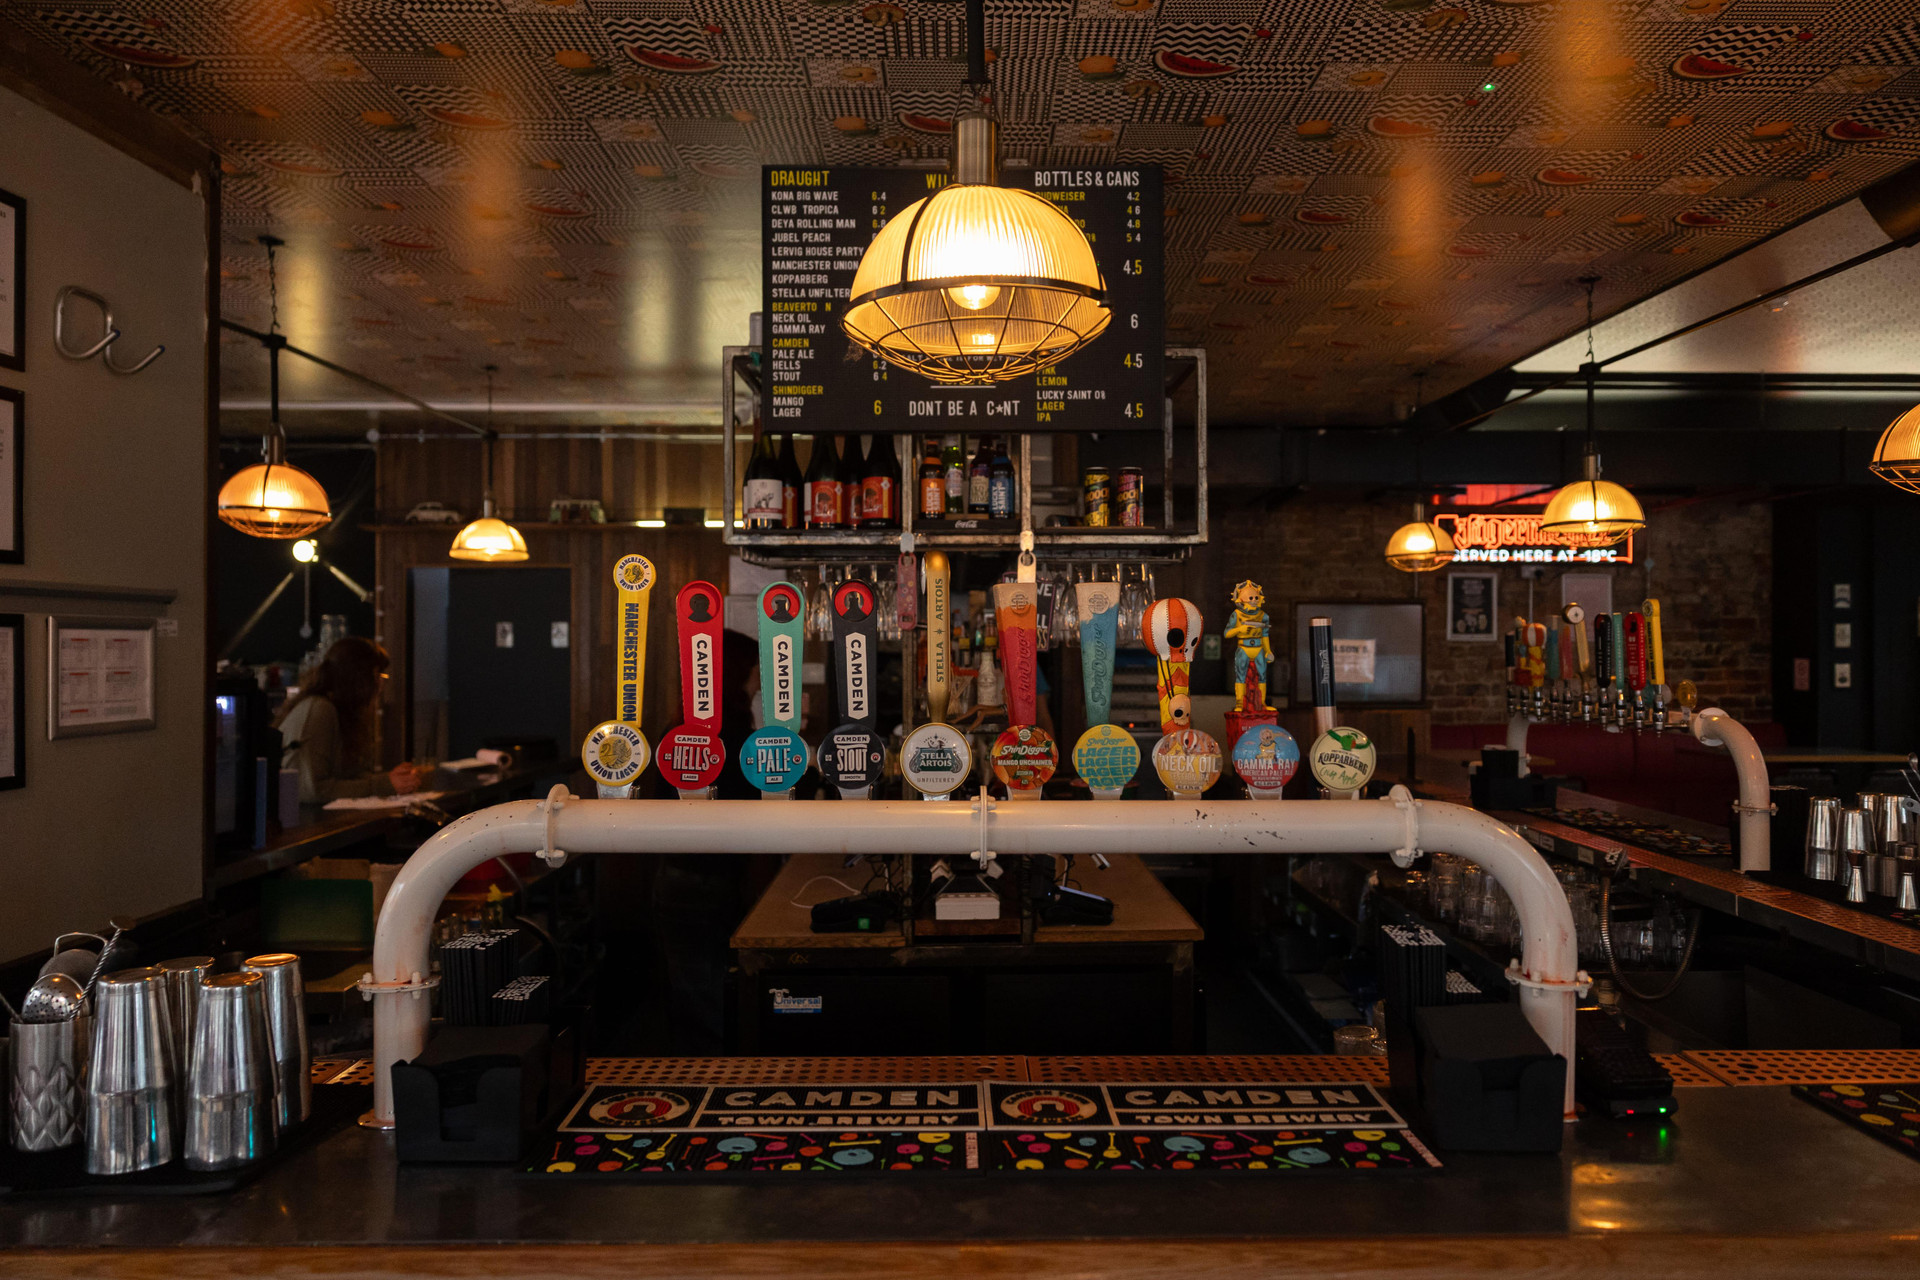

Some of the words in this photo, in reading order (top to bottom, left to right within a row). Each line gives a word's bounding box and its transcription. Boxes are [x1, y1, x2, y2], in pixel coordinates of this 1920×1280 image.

[771, 170, 830, 187] DRAUGHT
[1034, 170, 1092, 187] BOTTLES
[1095, 170, 1103, 187] &
[1106, 170, 1140, 187] CANS
[771, 191, 794, 201] KONA
[796, 191, 811, 201] BIG
[813, 191, 839, 201] WAVE
[1126, 191, 1141, 201] 4.2
[771, 205, 797, 215] CLWB
[803, 205, 839, 215] TROPICA
[771, 219, 795, 229] DEYA
[797, 219, 833, 229] ROLLING
[836, 219, 856, 229] MAN
[772, 233, 800, 243] JUBEL
[802, 233, 831, 243] PEACH
[771, 247, 803, 257] LERVIG
[805, 247, 833, 257] HOUSE
[836, 247, 864, 257] PARTY
[772, 261, 831, 271] MANCHESTER
[833, 261, 859, 271] UNION
[1123, 260, 1142, 275] 4.5
[772, 274, 828, 284] KOPPARBERG
[772, 288, 806, 298] STELLA
[772, 313, 794, 323] NECK
[797, 313, 811, 323] OIL
[1130, 313, 1139, 329] 6
[772, 324, 806, 334] GAMMA
[808, 324, 826, 334] RAY
[772, 338, 809, 348] CAMDEN
[772, 349, 795, 359] PALE
[797, 349, 814, 359] ALE
[772, 360, 801, 370] HELLS
[1123, 353, 1143, 368] 4.5
[772, 371, 801, 381] STOUT
[1036, 376, 1068, 386] LEMON
[772, 385, 823, 395] SHINDIGGER
[1036, 390, 1065, 400] LUCKY
[1067, 390, 1092, 400] SAINT
[772, 396, 804, 406] MANGO
[1036, 401, 1065, 411] LAGER
[873, 399, 882, 415] 6
[909, 400, 943, 416] DONT
[948, 400, 964, 416] BE
[969, 400, 978, 416] A
[1124, 403, 1144, 418] 4.5
[772, 408, 801, 418] LAGER
[1036, 412, 1051, 422] IPA
[1452, 548, 1510, 562] SERVED
[1512, 548, 1553, 562] HERE
[1556, 548, 1577, 562] AT
[619, 556, 649, 569] MANCHESTER
[620, 579, 634, 590] UNION
[635, 579, 649, 590] LAGER
[934, 578, 944, 623] ARTOIS
[622, 602, 640, 681] MANCHESTER
[936, 641, 944, 683] STELLA
[696, 640, 710, 712] CAMDEN
[777, 641, 790, 713] CAMDEN
[850, 639, 864, 711] CAMDEN
[622, 683, 637, 722] UNION
[676, 736, 708, 744] CAMDEN
[836, 735, 868, 743] CAMDEN
[920, 752, 952, 760] STELLA
[1000, 745, 1050, 756] ShinDigger
[1077, 746, 1137, 757] LAGER
[673, 745, 711, 771] HELLS
[756, 748, 791, 773] PALE
[836, 746, 868, 772] STOUT
[1077, 756, 1137, 767] LAGER
[1318, 751, 1369, 776] KOPPARBERG
[1161, 755, 1195, 772] NECK
[1199, 756, 1219, 773] OIL
[1237, 758, 1274, 770] GAMMA
[1278, 758, 1297, 770] RAY
[590, 760, 613, 780] UNION
[615, 761, 639, 780] LAGER
[1078, 766, 1137, 777] LAGER
[724, 1090, 959, 1107] CAMDEN
[1124, 1089, 1360, 1106] CAMDEN
[717, 1116, 805, 1126] TOWN
[815, 1115, 960, 1126] BREWERY
[1135, 1114, 1223, 1124] TOWN
[1233, 1113, 1372, 1124] BREWERY
